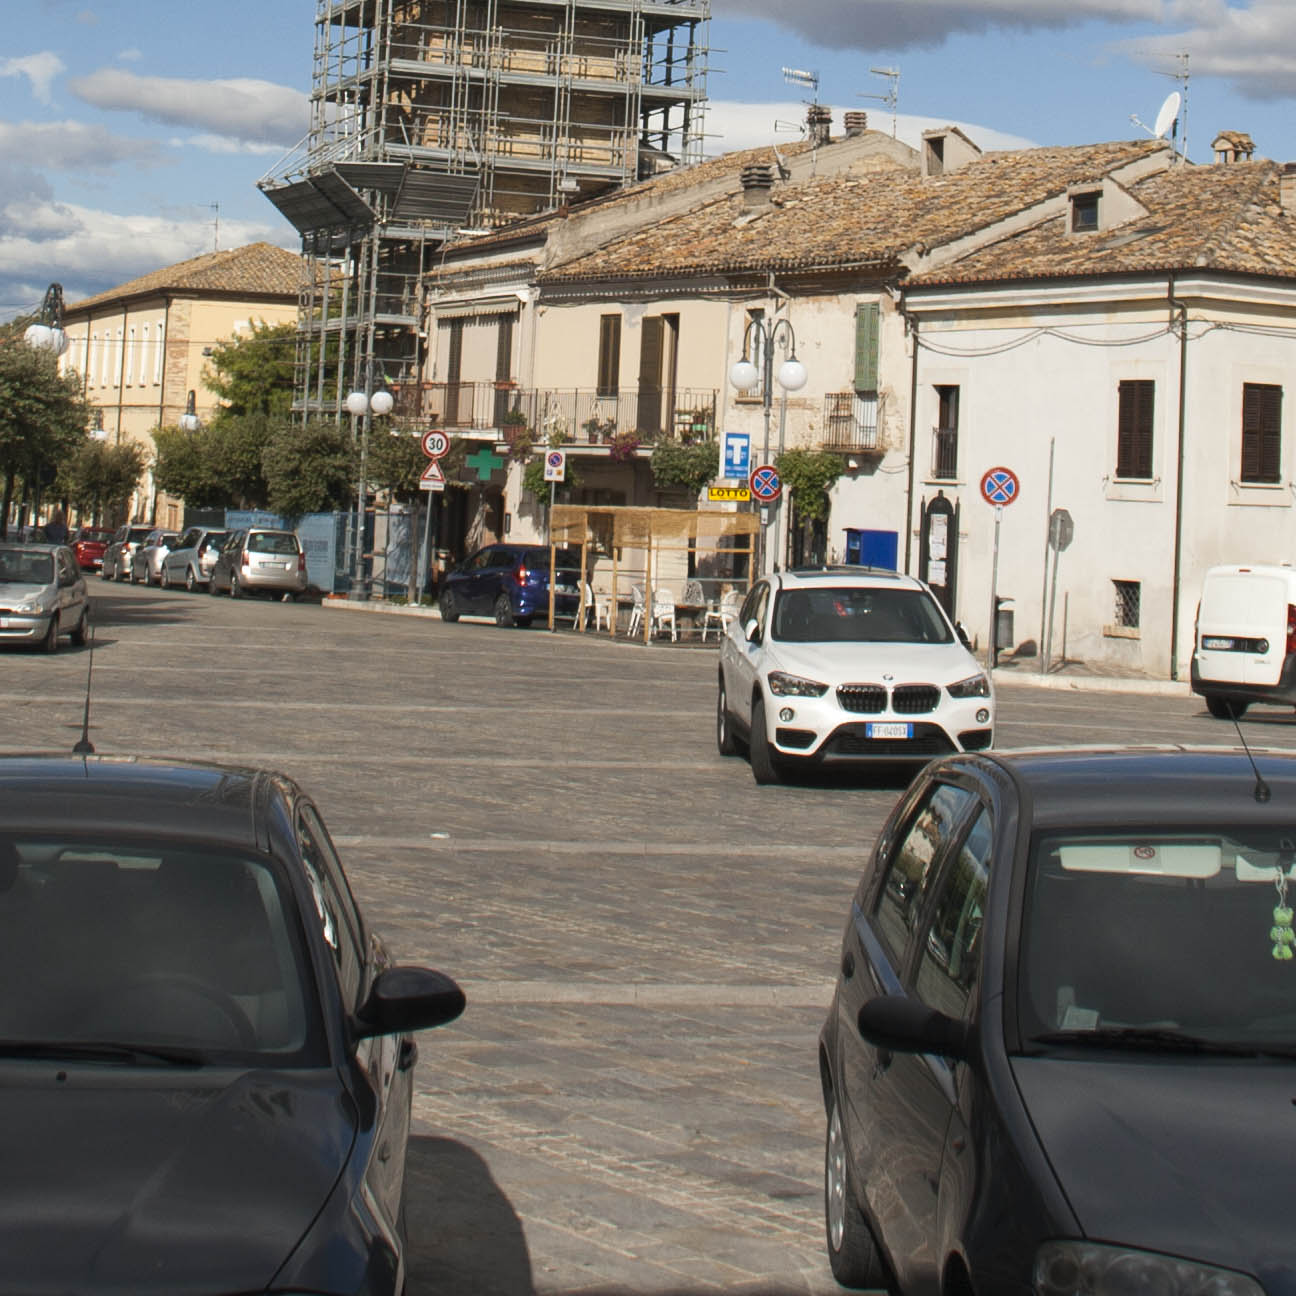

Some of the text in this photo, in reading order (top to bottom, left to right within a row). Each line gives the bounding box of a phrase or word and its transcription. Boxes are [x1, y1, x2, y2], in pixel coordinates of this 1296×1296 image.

[429, 438, 444, 450] 30
[727, 437, 748, 464] T
[710, 488, 748, 497] LOTTO
